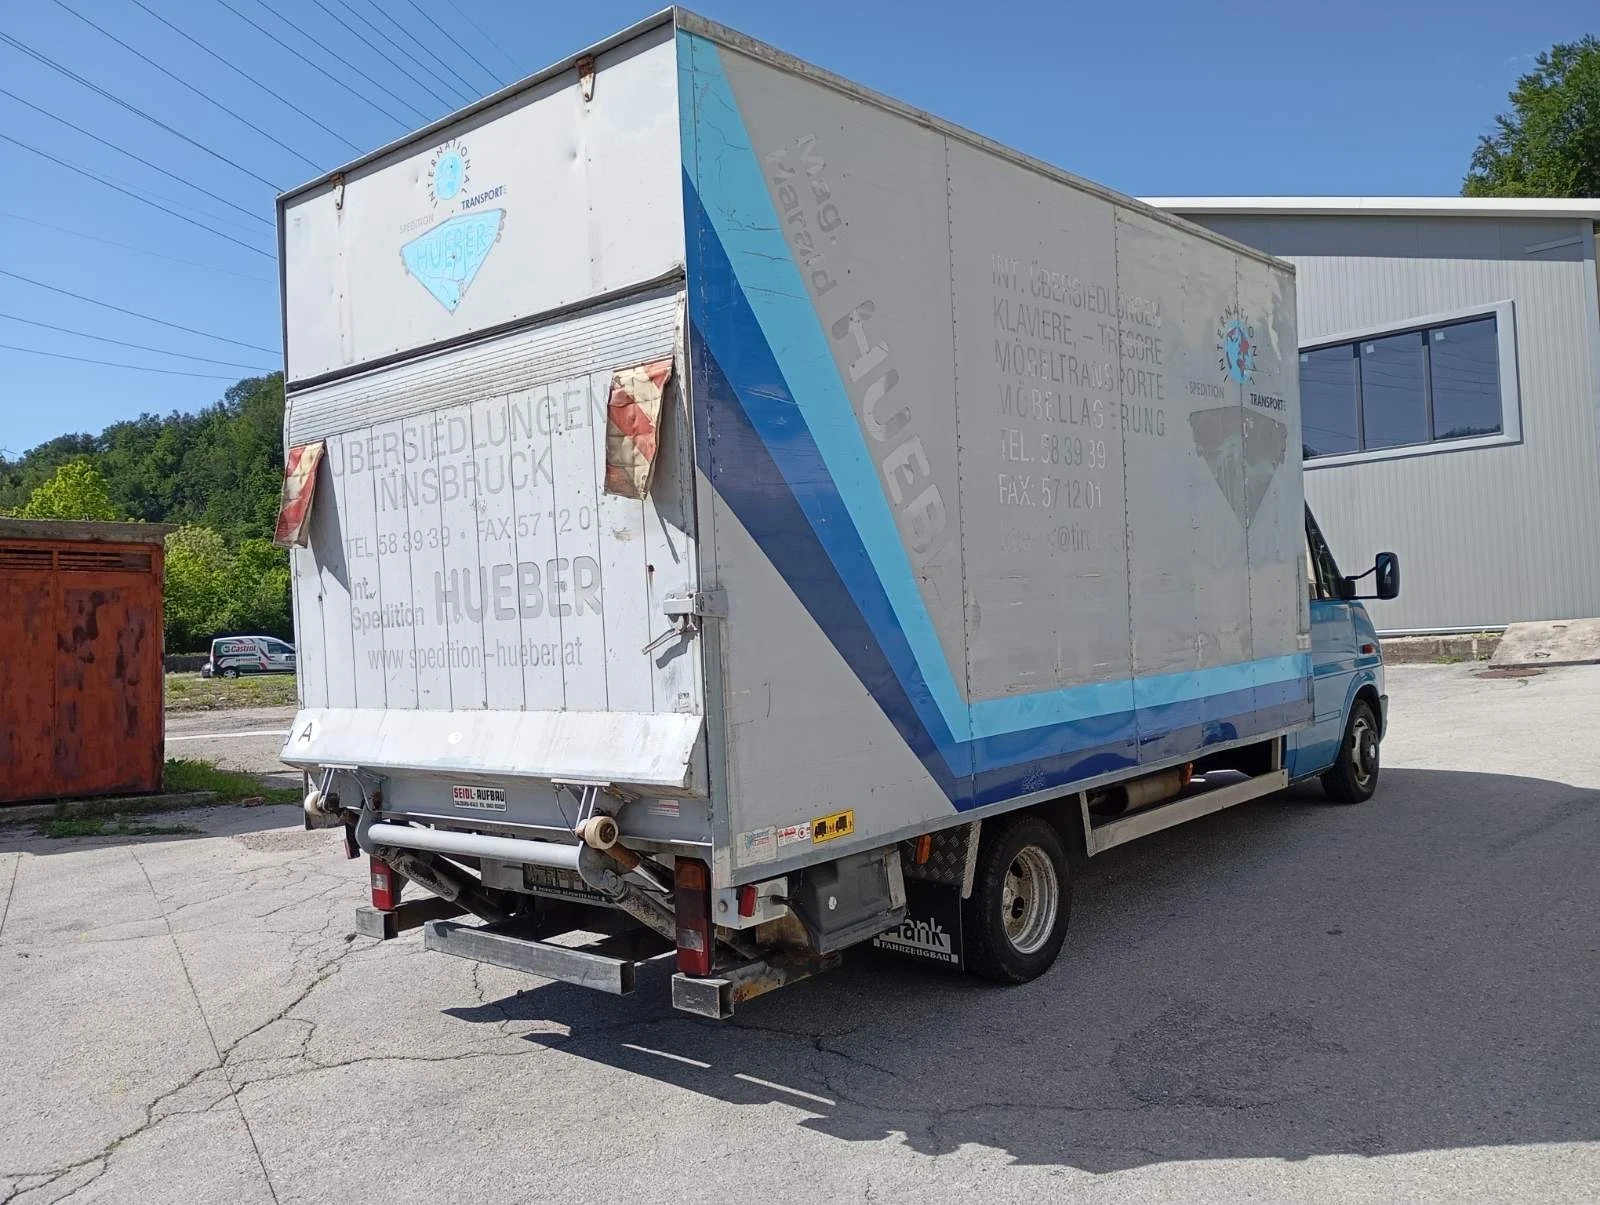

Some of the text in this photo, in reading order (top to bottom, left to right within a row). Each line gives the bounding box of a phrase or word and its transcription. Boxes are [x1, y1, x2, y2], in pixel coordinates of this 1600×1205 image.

[428, 139, 472, 208] INTERNATIONAL
[416, 222, 488, 271] HUEBER
[1097, 324, 1164, 365] TRESORE
[994, 337, 1165, 401] MÖBELTRANSPORTE
[1189, 381, 1225, 399] SPEDITION
[999, 427, 1106, 469] TEL. 58 39 39
[374, 446, 554, 512] NNSBRUCK
[998, 472, 1036, 507] FAX.
[1042, 477, 1061, 508] 57
[379, 532, 398, 556] 58
[402, 529, 423, 553] 39
[427, 526, 450, 549] 39
[518, 512, 542, 537] 57
[352, 555, 602, 636] Spedition HUEBER
[231, 645, 257, 653] Castrol
[298, 722, 314, 743] A
[881, 941, 951, 962] FAHRZEUGBAU
[884, 917, 945, 948] ank
